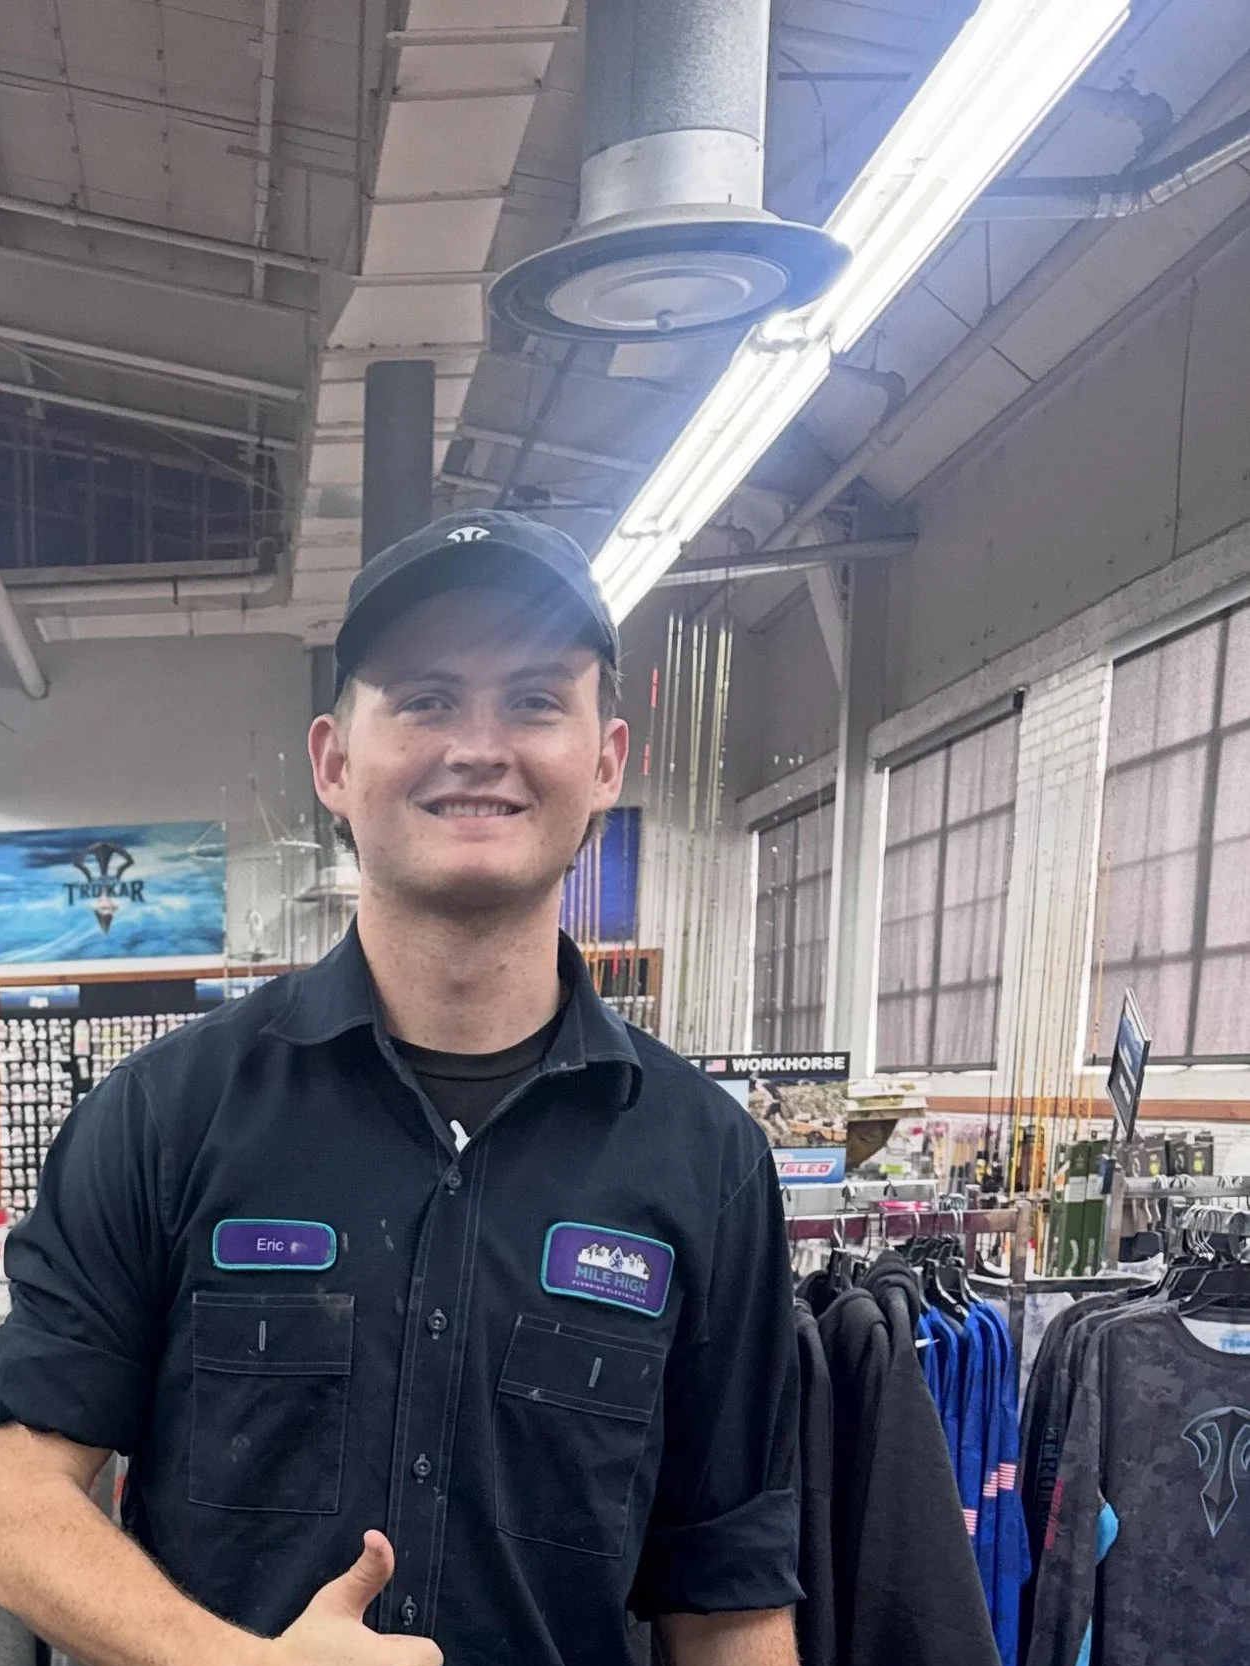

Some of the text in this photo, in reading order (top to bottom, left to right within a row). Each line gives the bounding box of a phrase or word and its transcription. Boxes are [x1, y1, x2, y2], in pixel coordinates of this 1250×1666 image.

[731, 1056, 846, 1072] WORKHORSE
[256, 1237, 285, 1252] Eric
[574, 1263, 648, 1297] MILE HIGH
